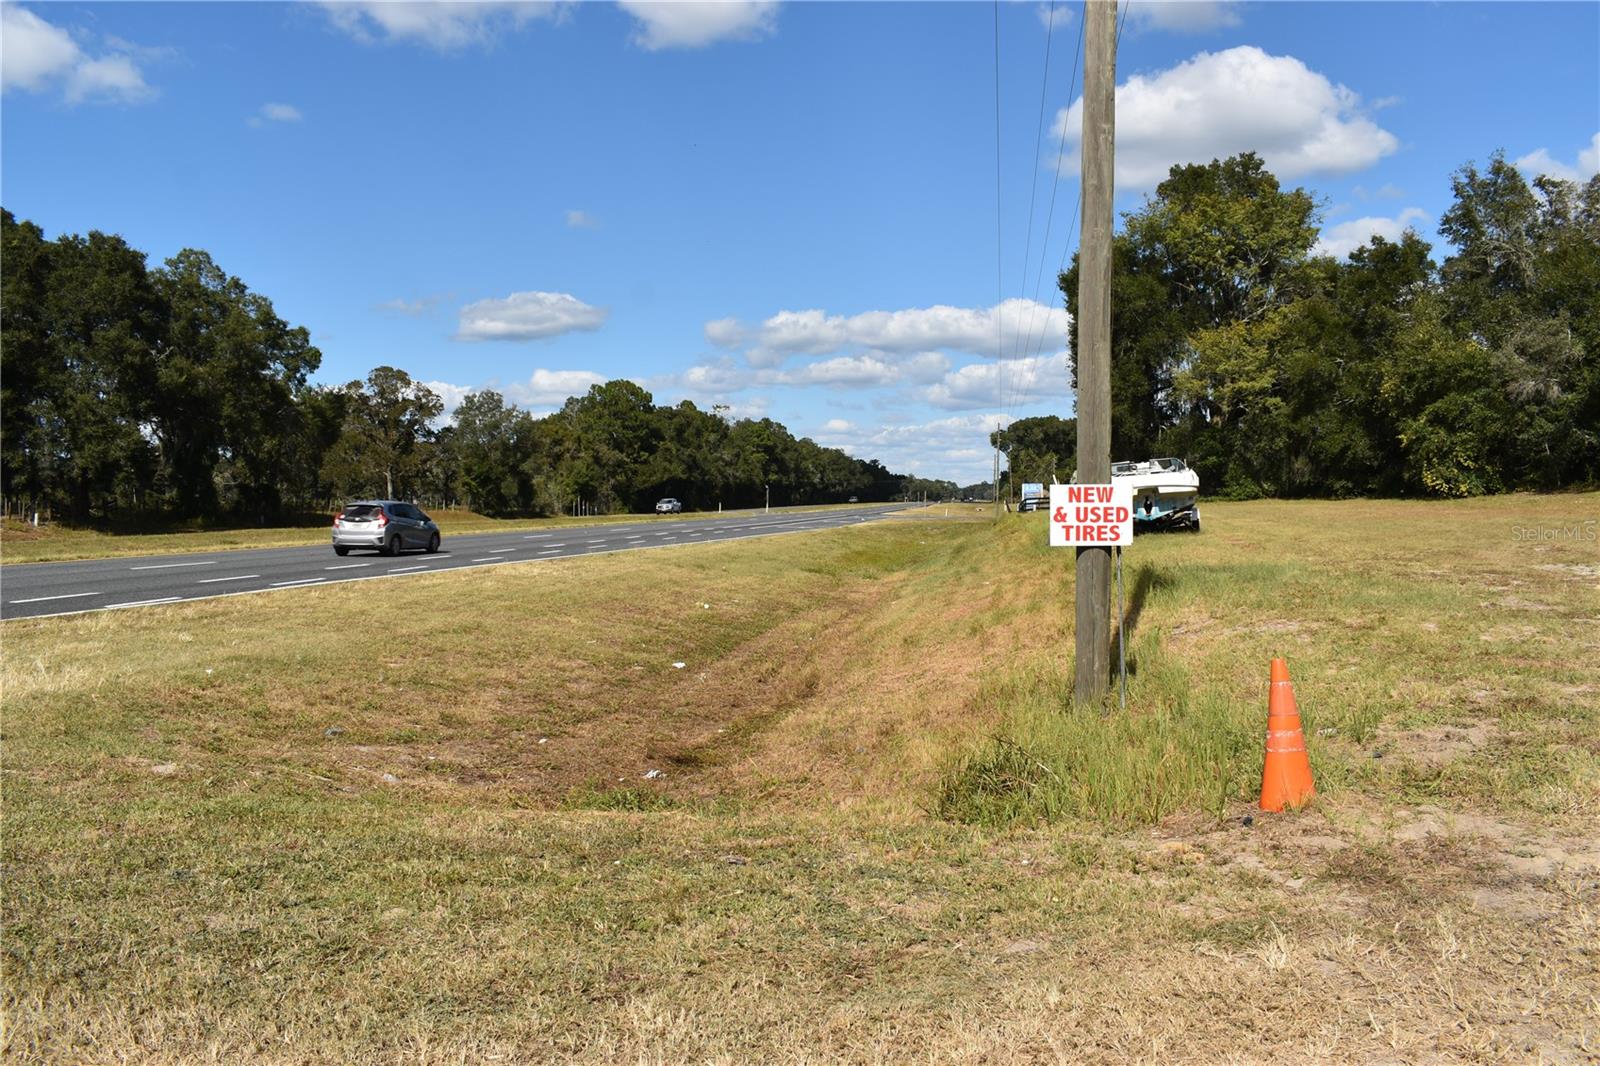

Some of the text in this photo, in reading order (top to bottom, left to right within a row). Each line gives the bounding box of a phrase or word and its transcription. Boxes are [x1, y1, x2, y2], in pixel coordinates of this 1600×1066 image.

[1068, 487, 1114, 503] NEW
[1053, 506, 1129, 523] & USED
[1061, 525, 1121, 542] TIRES
